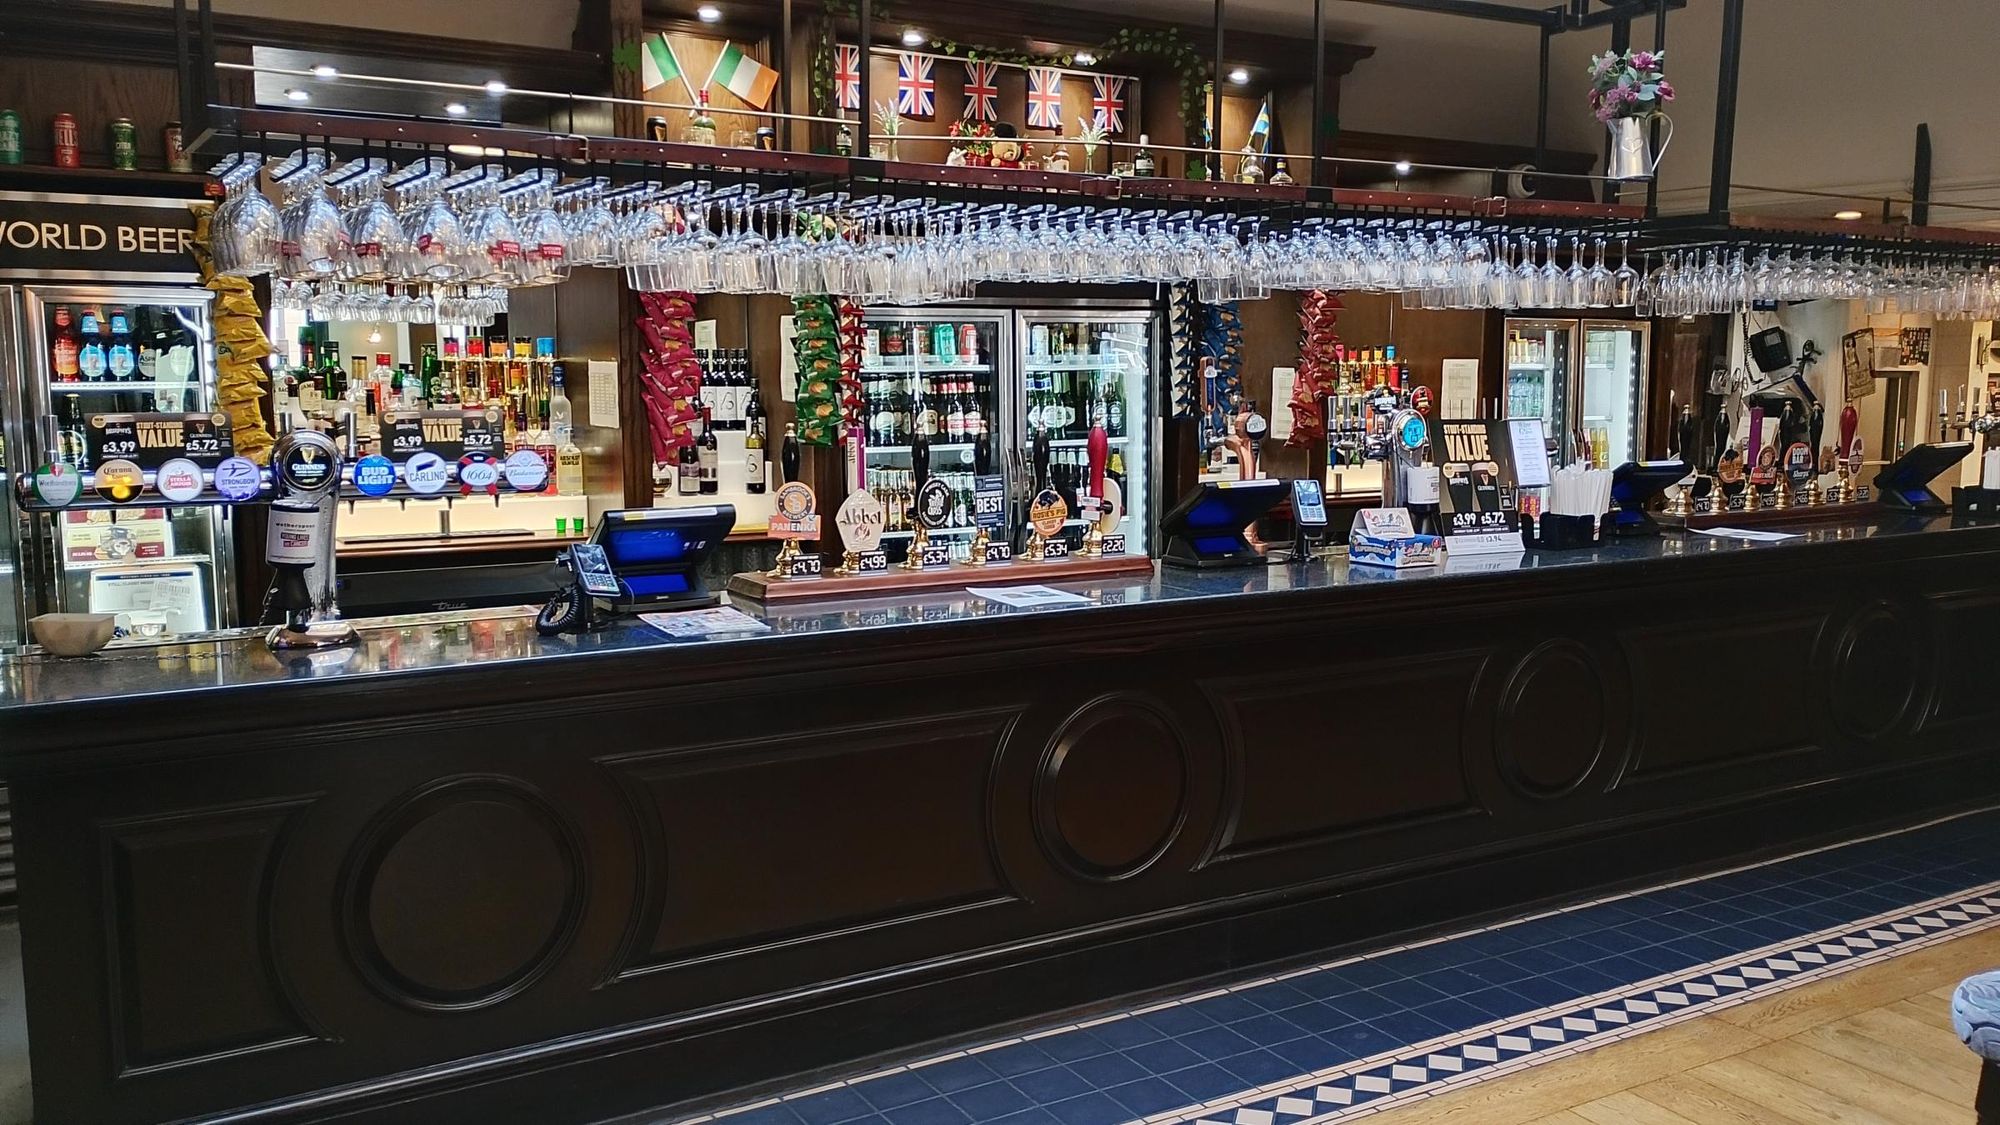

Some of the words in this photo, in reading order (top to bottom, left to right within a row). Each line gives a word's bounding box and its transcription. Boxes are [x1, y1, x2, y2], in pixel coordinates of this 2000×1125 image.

[137, 429, 185, 448] VALUE
[422, 425, 463, 442] VALUE
[186, 440, 219, 451] £5.72
[393, 436, 422, 447] £3.99
[464, 435, 492, 445] £5.72
[102, 441, 136, 453] £3.99
[1444, 434, 1491, 461] VALUE
[1792, 446, 1809, 455] DOOM
[103, 467, 133, 475] Corona
[291, 464, 327, 472] GUINNESS
[361, 466, 390, 476] BUD
[357, 475, 394, 485] LIGHT
[409, 471, 445, 482] CARLING
[466, 469, 493, 481] 1664
[977, 497, 1003, 513] BEST
[839, 508, 881, 525] Abbot
[1032, 510, 1055, 519] ROSIE'S
[1453, 512, 1477, 526] £3.99
[1481, 511, 1506, 524] £5.72
[771, 522, 817, 532] PANENKA
[1045, 544, 1068, 557] £5.34
[1102, 540, 1125, 553] £2.20
[860, 556, 886, 569] £4.99
[923, 551, 949, 564] £5.34
[793, 559, 820, 574] £4.70
